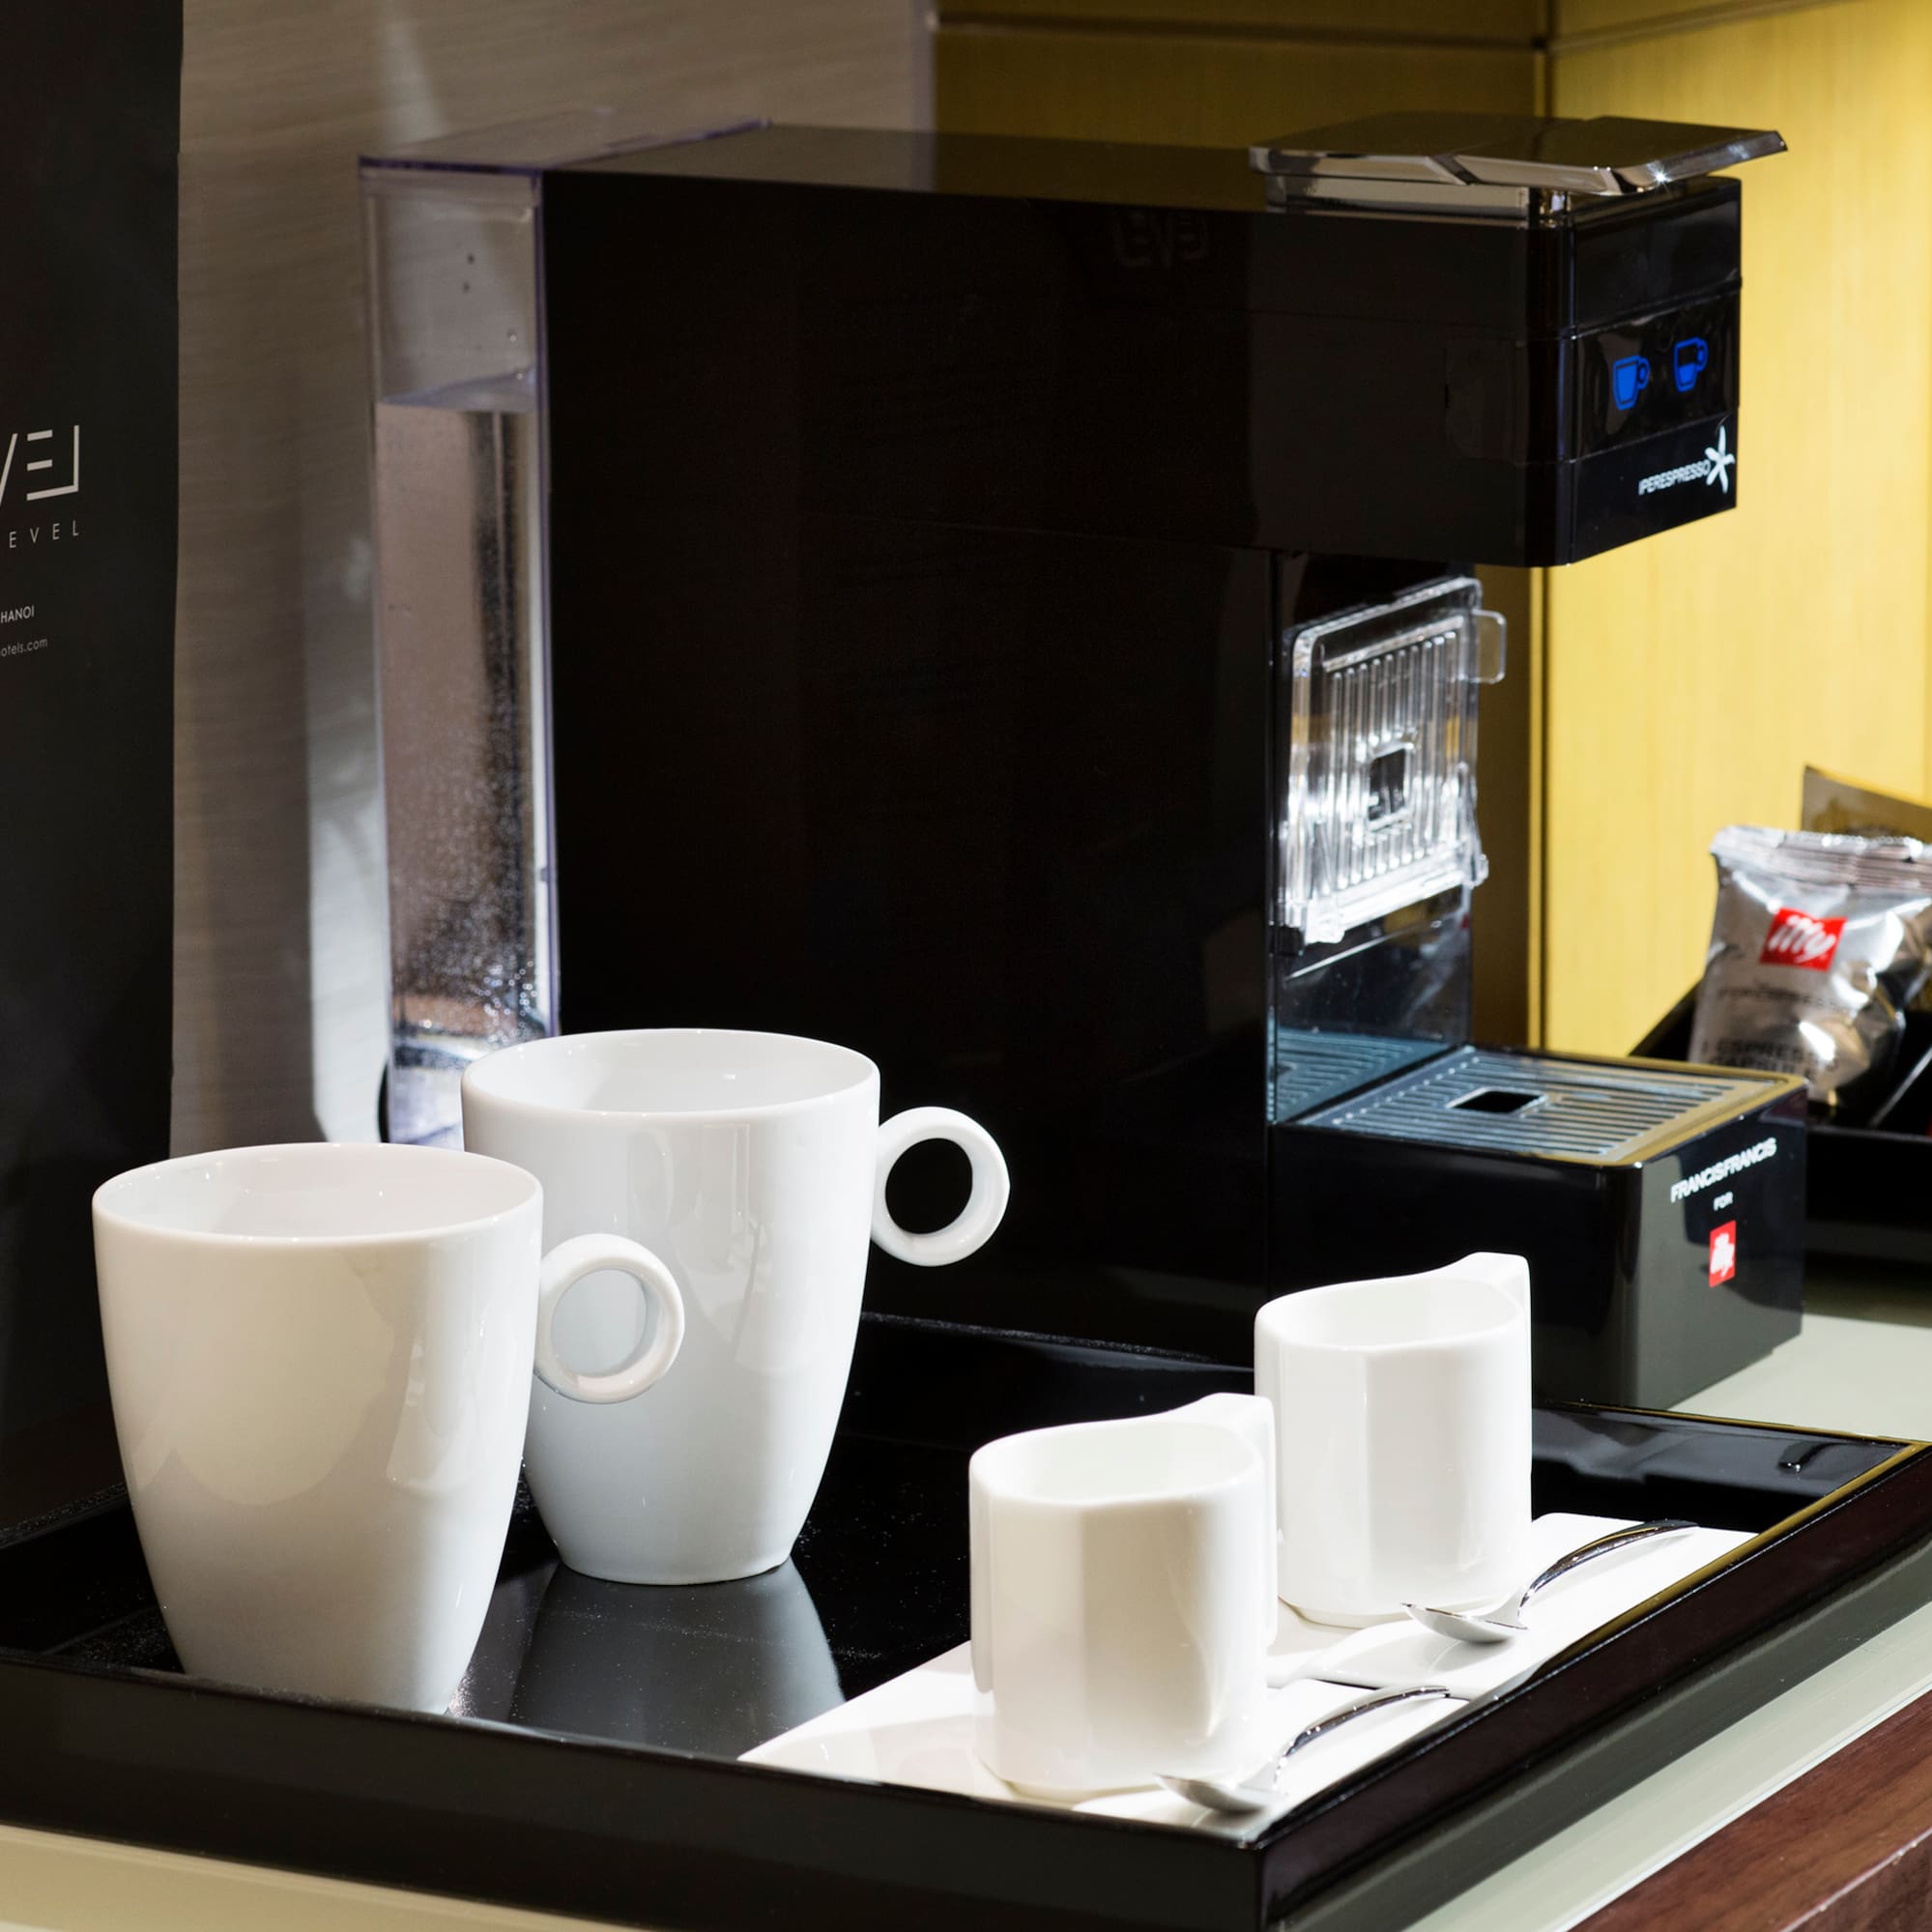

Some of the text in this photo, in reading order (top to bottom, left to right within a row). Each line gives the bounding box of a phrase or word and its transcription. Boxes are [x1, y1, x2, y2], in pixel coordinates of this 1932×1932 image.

[1638, 459, 1711, 496] IPERESPRESSO
[0, 605, 35, 623] HANOI
[0, 638, 48, 657] otels.com
[1769, 914, 1835, 964] illy
[1670, 1137, 1777, 1203] FRANCISFRANCIS
[1713, 1192, 1733, 1211] FOR
